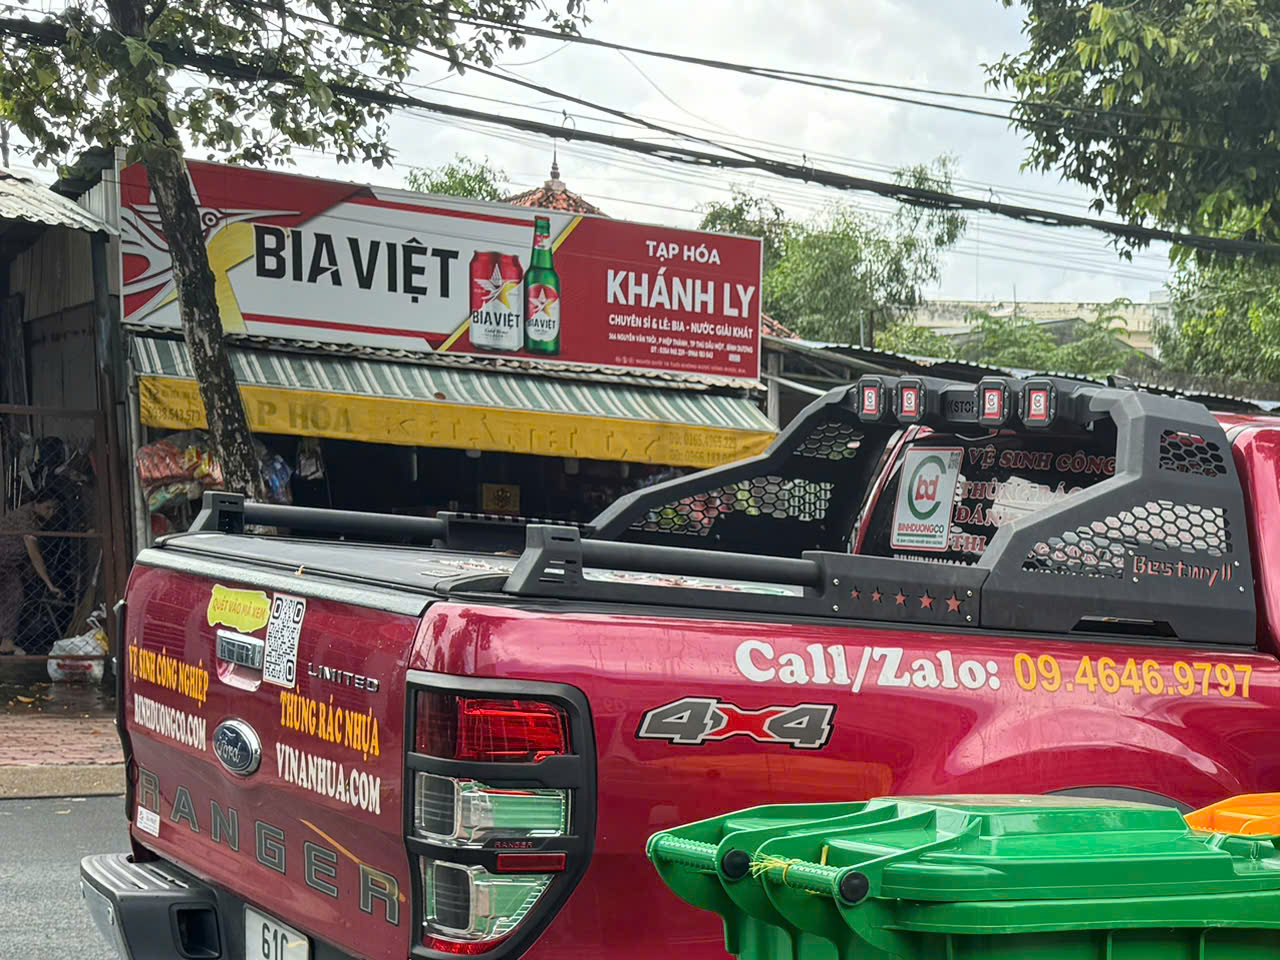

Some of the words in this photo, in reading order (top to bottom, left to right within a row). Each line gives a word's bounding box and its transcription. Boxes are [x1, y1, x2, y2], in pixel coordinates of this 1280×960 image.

[254, 224, 342, 287] BIA
[347, 236, 459, 303] VIỆT
[646, 240, 679, 262] TẠP
[683, 244, 721, 265] HÓA
[607, 267, 714, 314] KHÁNH
[723, 283, 755, 318] LY
[472, 311, 492, 326] BIA
[494, 312, 521, 330] VIỆT
[969, 444, 996, 470] VỆ
[1000, 449, 1053, 470] SINH
[1056, 450, 1117, 475] CÔNG
[156, 646, 177, 691] CÔNG
[308, 662, 380, 693] LIMITED
[734, 639, 1001, 693] Call/Zalo:
[1013, 651, 1253, 698] 09.4646.9797
[134, 693, 207, 752] BINHDUONGCO.COM
[279, 685, 317, 736] THÙNG
[318, 694, 343, 745] RÁC
[345, 707, 381, 763] NHỰA
[215, 739, 241, 763] Ford
[275, 742, 381, 815] VINANHUA.COM
[138, 767, 400, 926] RANGER
